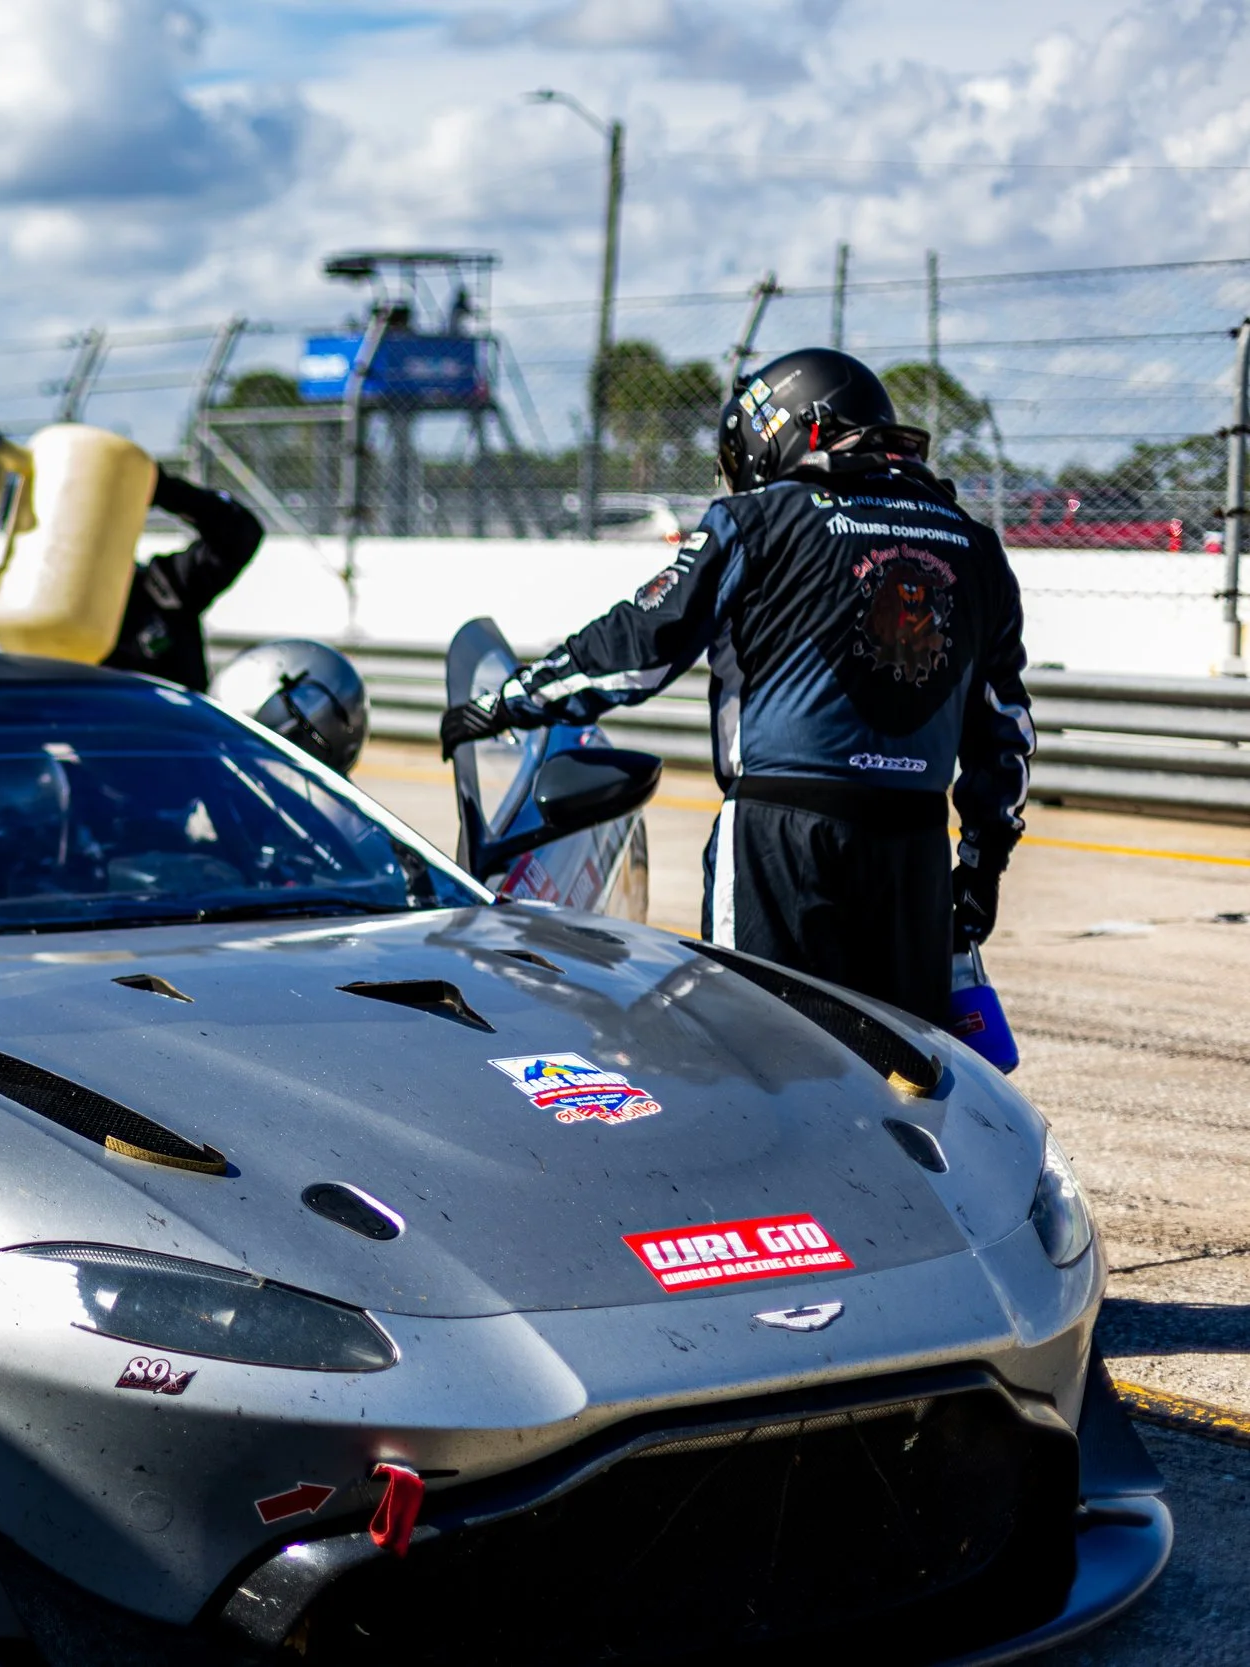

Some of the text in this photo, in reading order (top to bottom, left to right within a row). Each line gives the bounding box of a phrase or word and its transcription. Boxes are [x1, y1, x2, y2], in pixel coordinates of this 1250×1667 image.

[892, 525, 969, 547] COMPONENTS
[518, 1076, 571, 1096] BASE
[642, 1222, 829, 1270] WRL GTO
[661, 1251, 847, 1286] WORLD RACING LEAGUE
